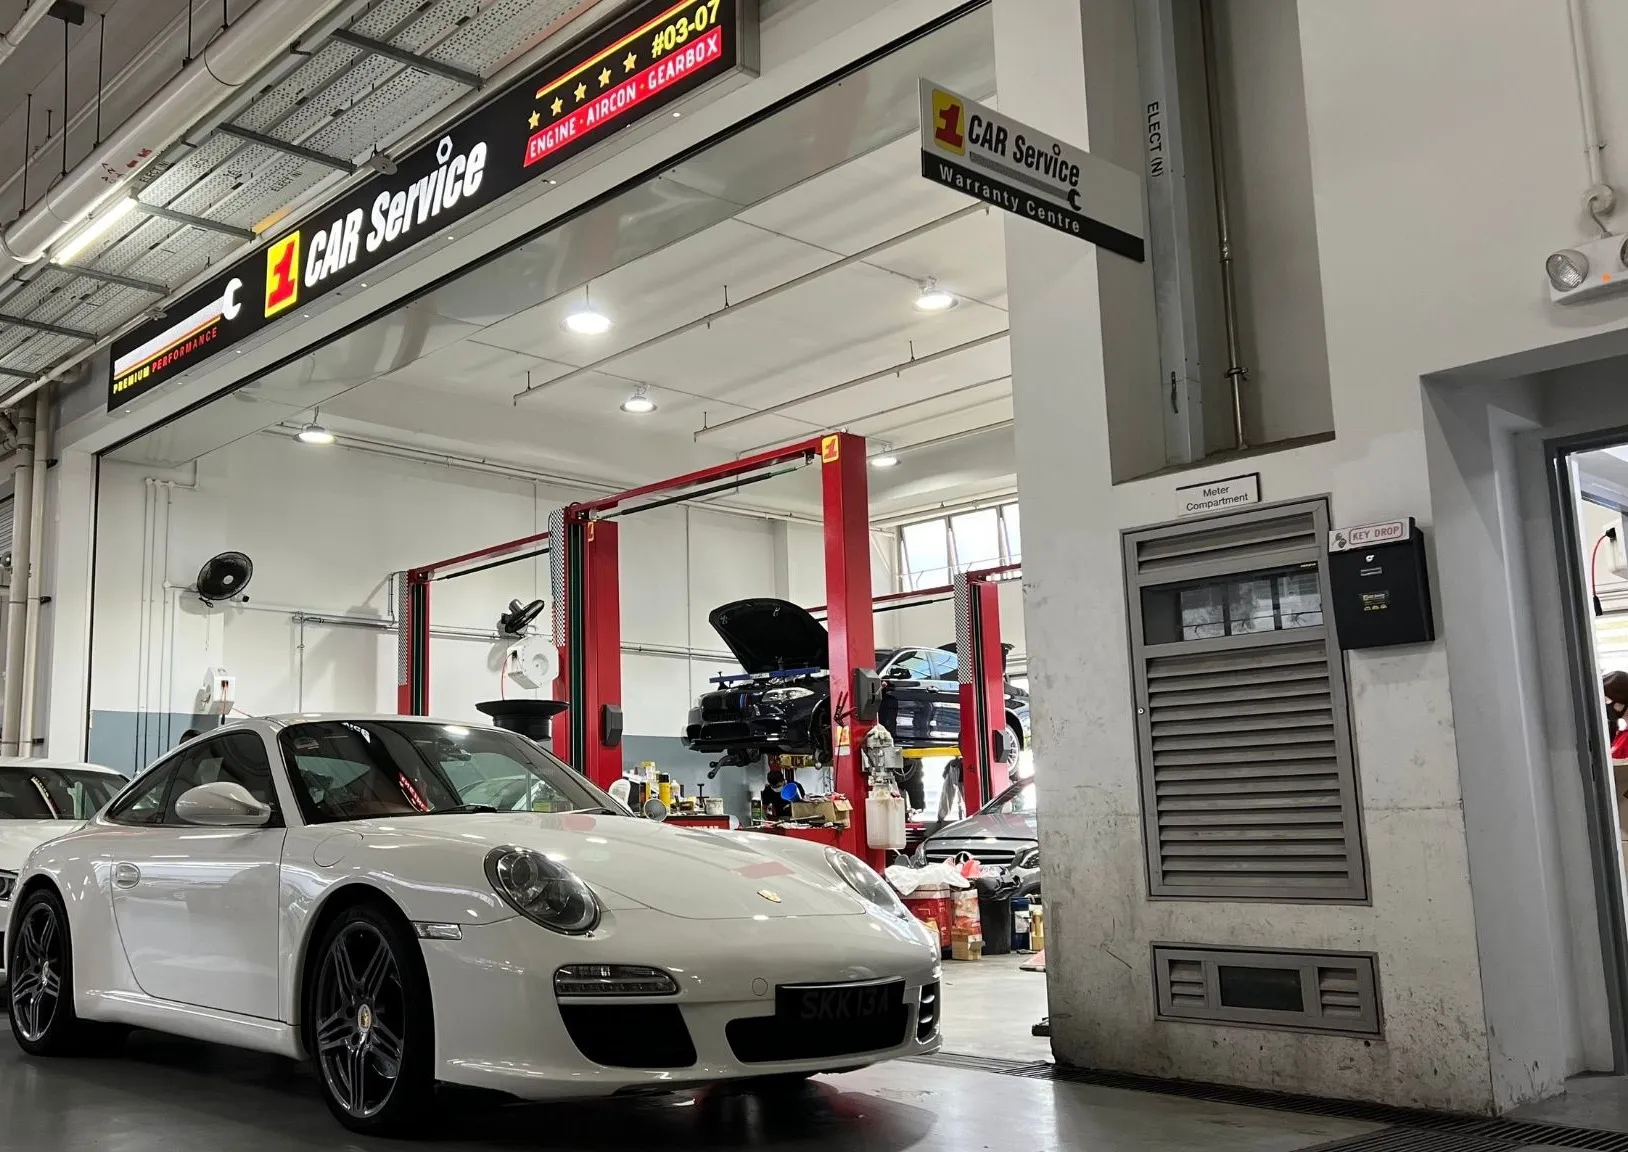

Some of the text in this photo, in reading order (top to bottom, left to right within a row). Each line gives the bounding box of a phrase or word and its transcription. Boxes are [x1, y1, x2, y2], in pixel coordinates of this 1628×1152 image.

[651, 0, 721, 58] #03-07
[530, 34, 720, 159] ENGINE AIRCON GEARBOX
[935, 103, 1081, 188] 1 CAR Service
[1147, 101, 1164, 177] ELECT (N)
[266, 136, 488, 309] 1 CAR Service
[939, 163, 1081, 233] Warranty Centre
[113, 326, 218, 395] PREMIUM PERFORMANCE
[1186, 492, 1249, 511] Compartment
[1203, 486, 1230, 498] Meter
[1352, 526, 1400, 541] KEY DROP
